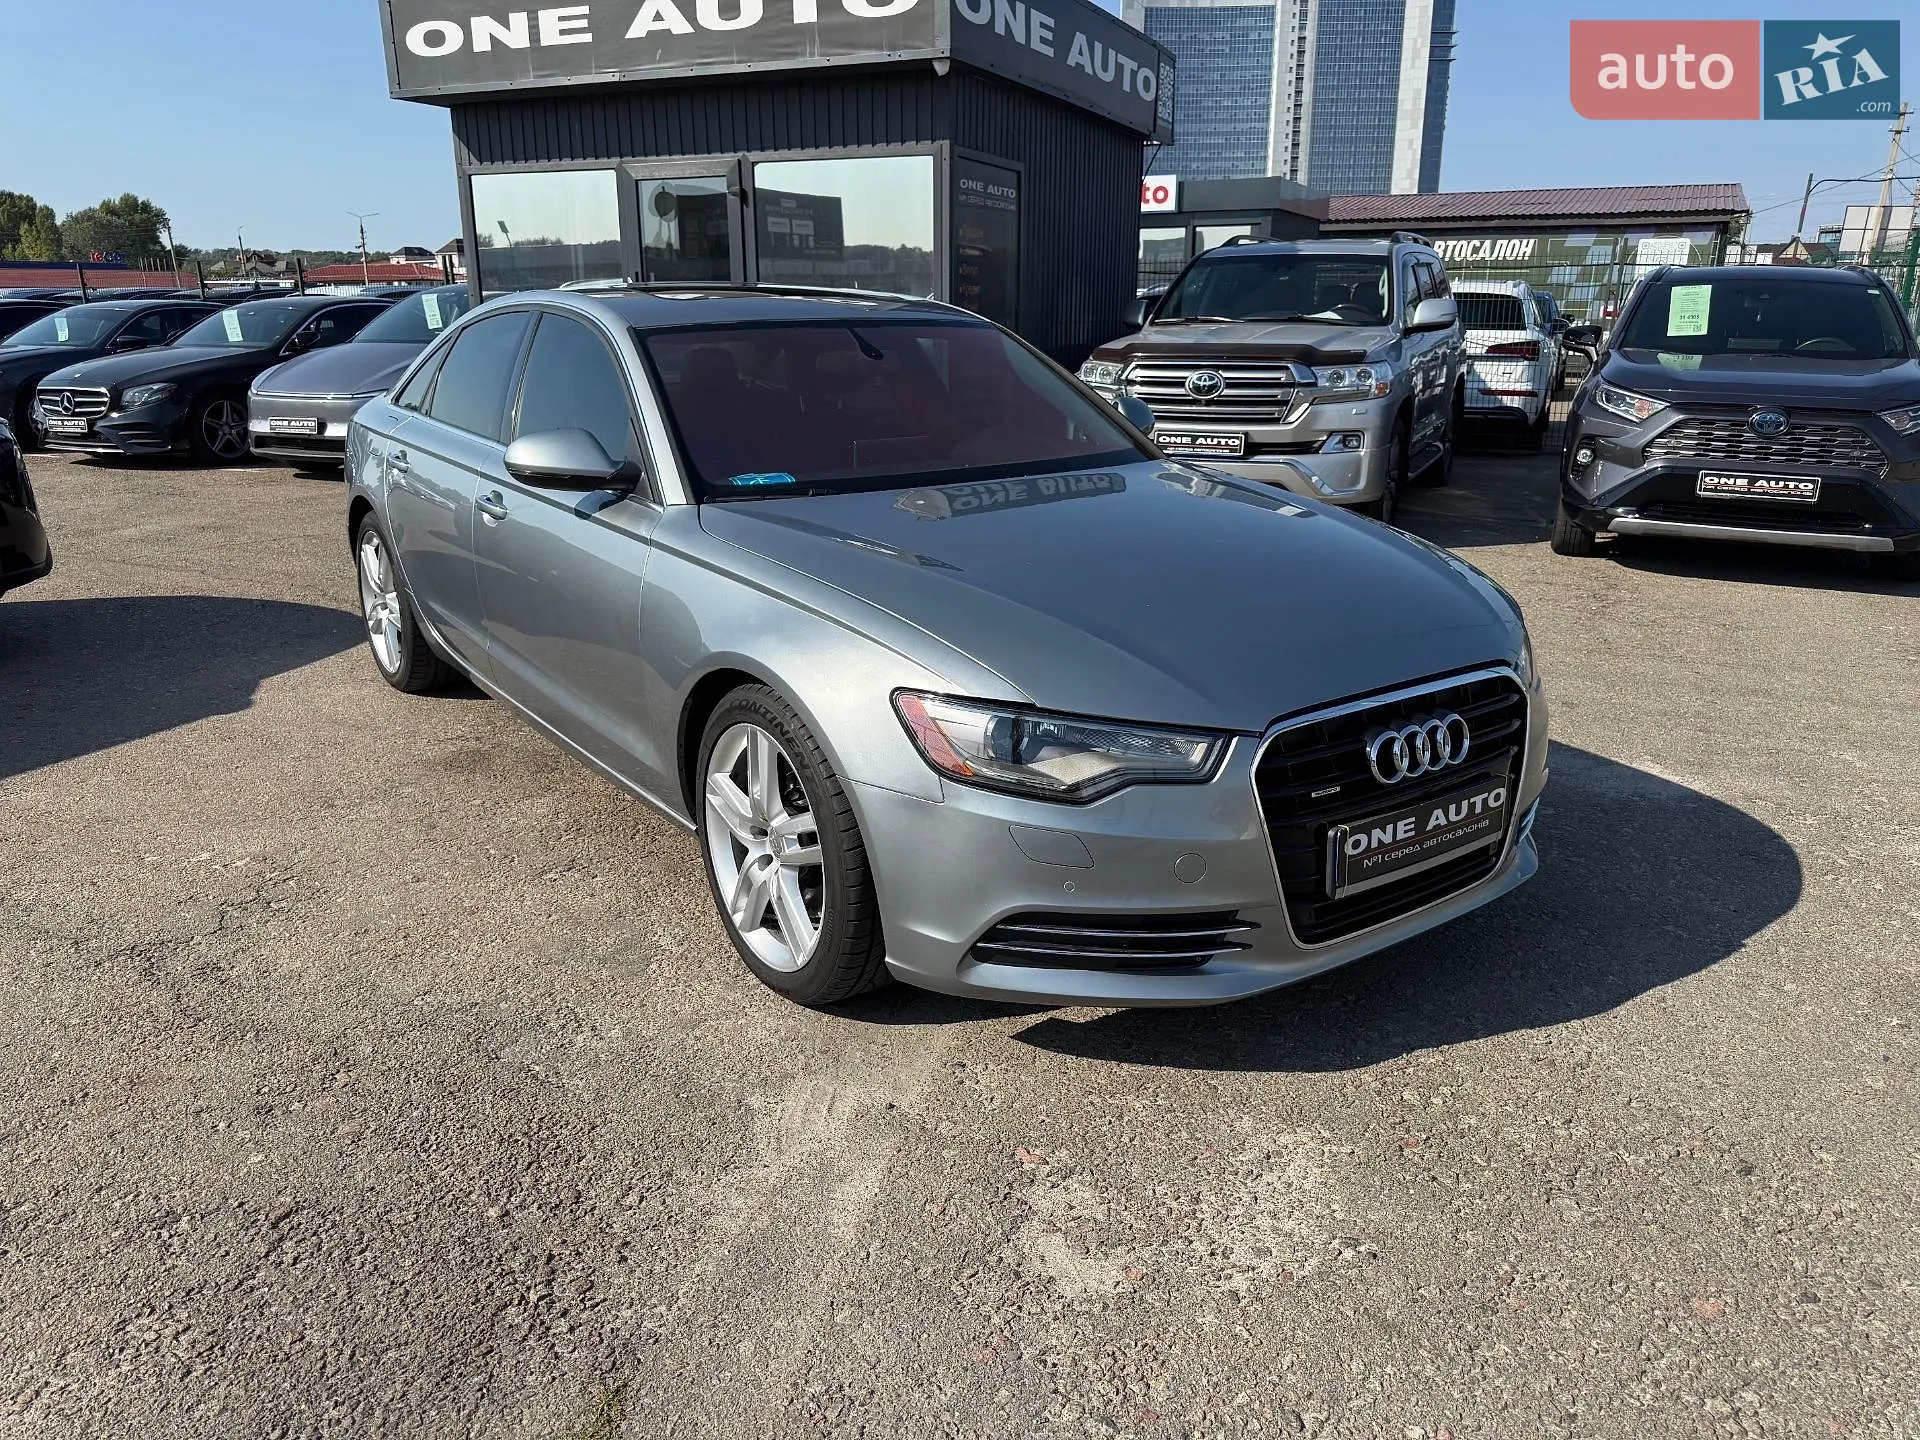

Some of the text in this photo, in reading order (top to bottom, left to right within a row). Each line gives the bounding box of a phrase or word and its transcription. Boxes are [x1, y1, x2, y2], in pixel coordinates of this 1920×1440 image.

[406, 5, 593, 57] ONE
[1066, 31, 1157, 101] AUTO
[960, 179, 1016, 198] ONE AUTO
[1433, 239, 1536, 261] ВТОСАЛОН
[1159, 435, 1240, 446] ONE AUTO
[1704, 476, 1814, 490] ONE AUTO
[1345, 787, 1506, 856] ONE AUTO
[1384, 844, 1421, 861] серед
[1423, 818, 1489, 849] автосалонів
